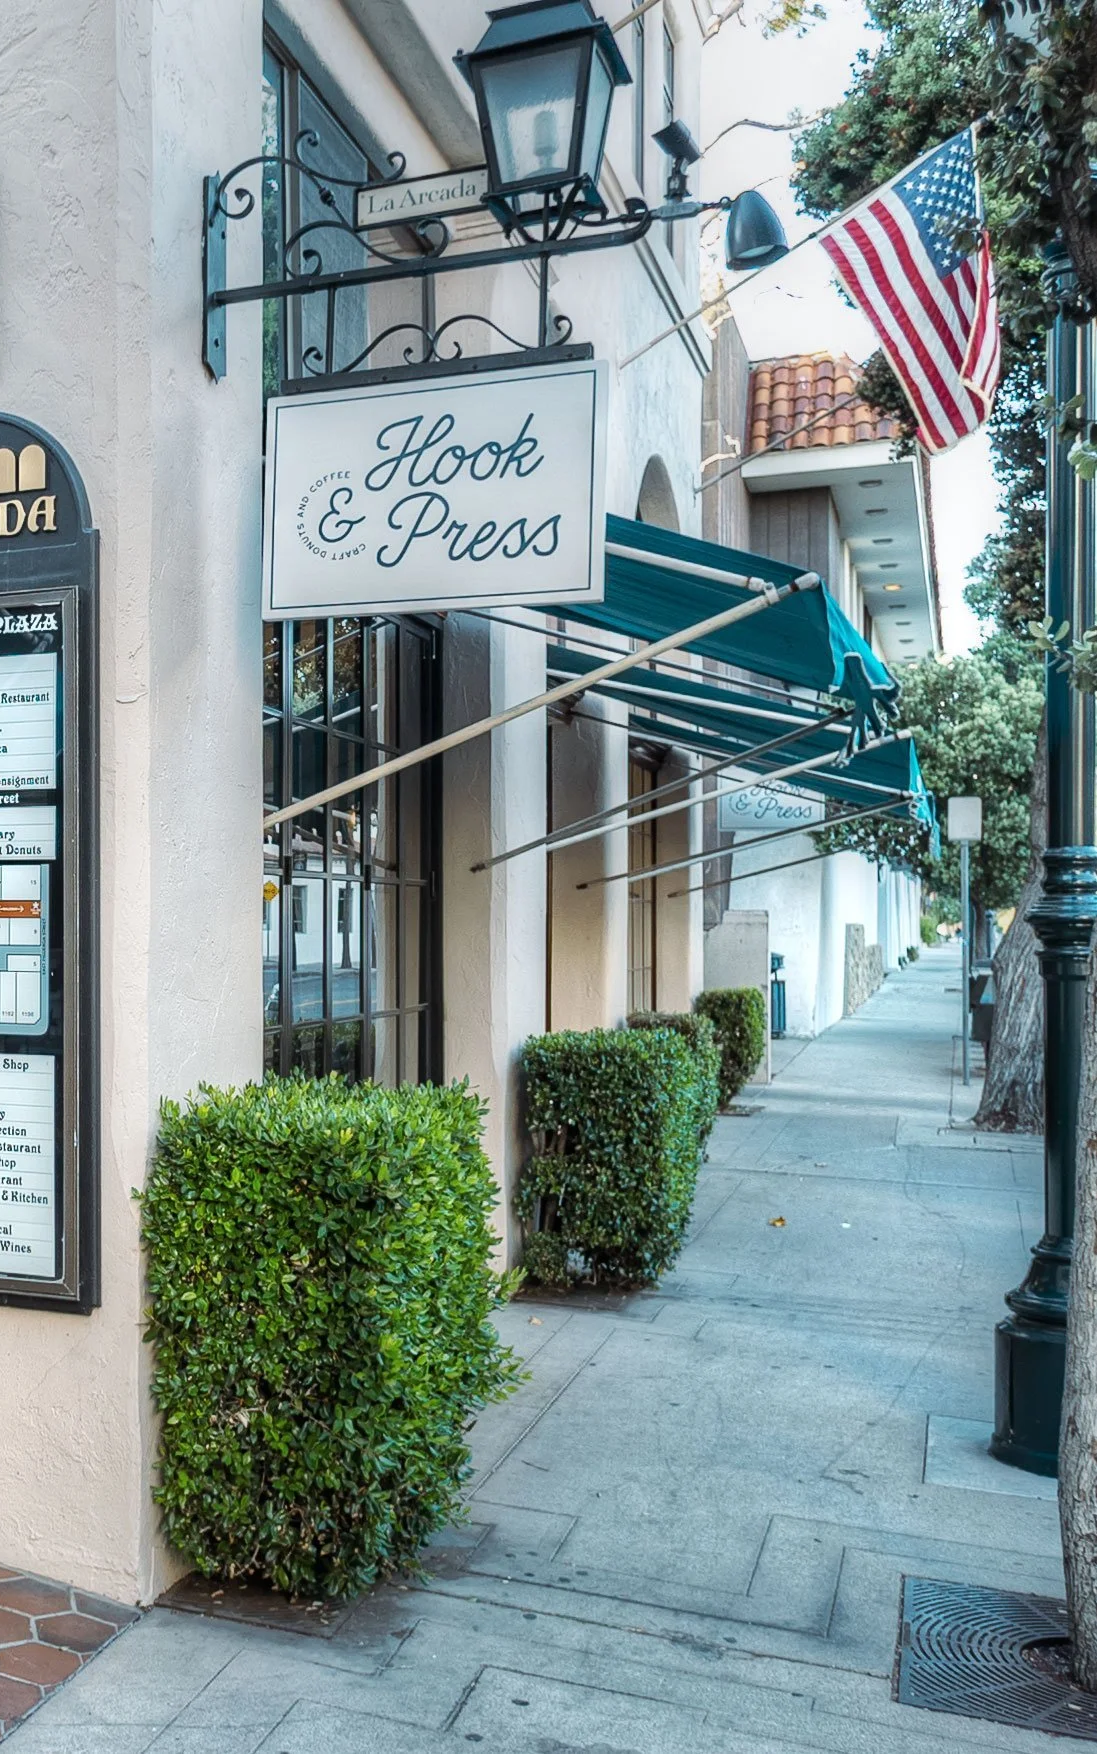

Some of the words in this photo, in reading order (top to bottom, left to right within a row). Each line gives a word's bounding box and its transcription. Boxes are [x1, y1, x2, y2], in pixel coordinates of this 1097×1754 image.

[368, 195, 394, 214] La
[399, 179, 475, 209] Arcada
[365, 413, 544, 491] Hook
[309, 471, 350, 493] COFFEE
[297, 496, 309, 518] AND
[318, 487, 366, 543] &
[376, 491, 561, 568] Press
[297, 523, 327, 558] DONUTS
[332, 543, 366, 560] CRAFT
[1, 692, 50, 704] Restaurant
[755, 797, 812, 819] Press
[6, 844, 42, 855] Donuts
[3, 1058, 29, 1072] Shop
[2, 1190, 8, 1201] &
[11, 1191, 48, 1204] Kitchen
[0, 1240, 32, 1253] Wines
